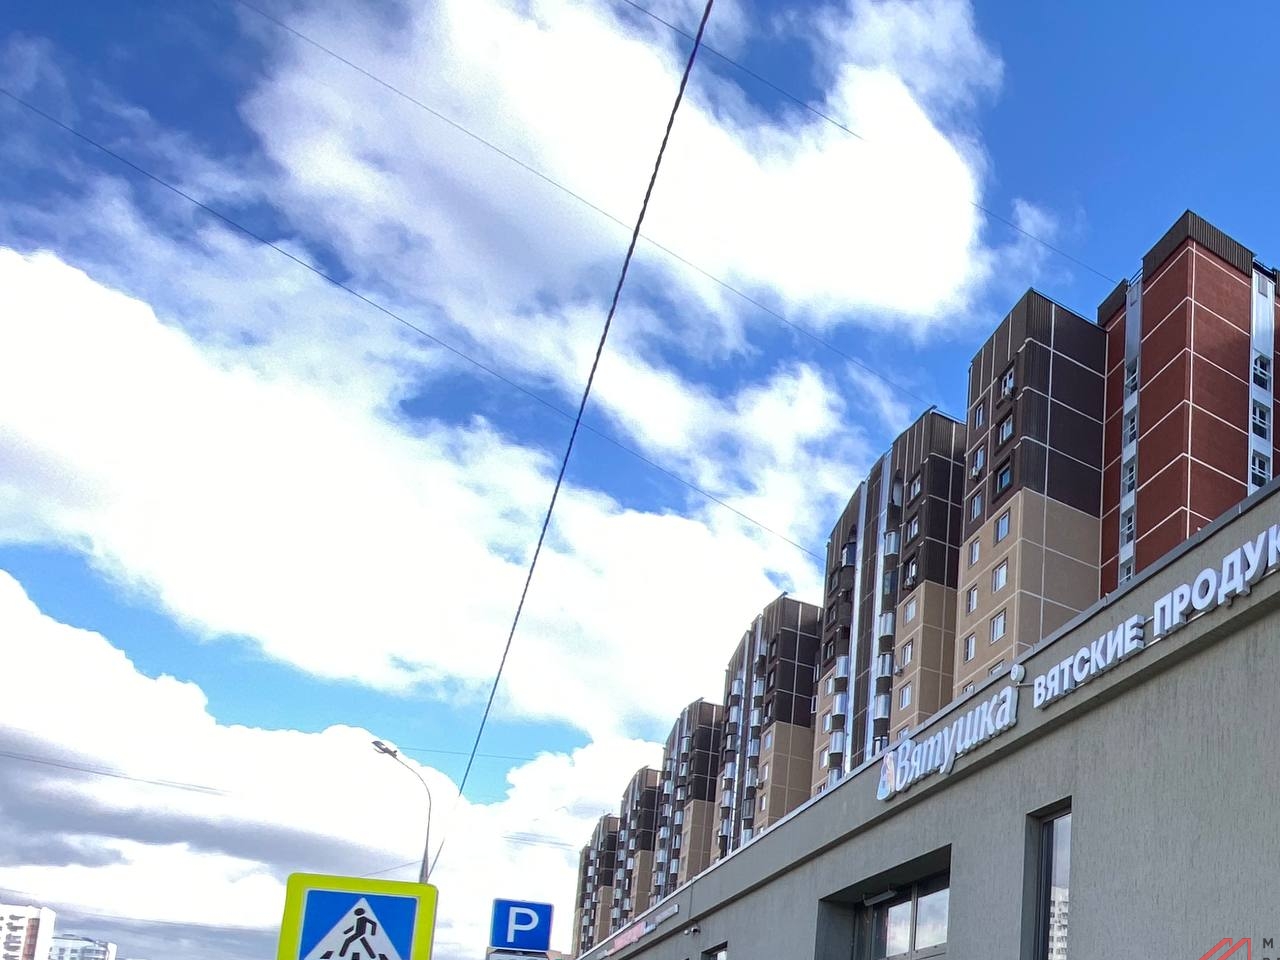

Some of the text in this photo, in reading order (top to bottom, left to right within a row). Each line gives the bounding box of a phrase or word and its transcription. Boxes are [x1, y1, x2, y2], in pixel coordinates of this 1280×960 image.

[1033, 614, 1143, 709] ВЯТСКИЕ
[895, 685, 1016, 792] Вятушка
[506, 906, 539, 943] P
